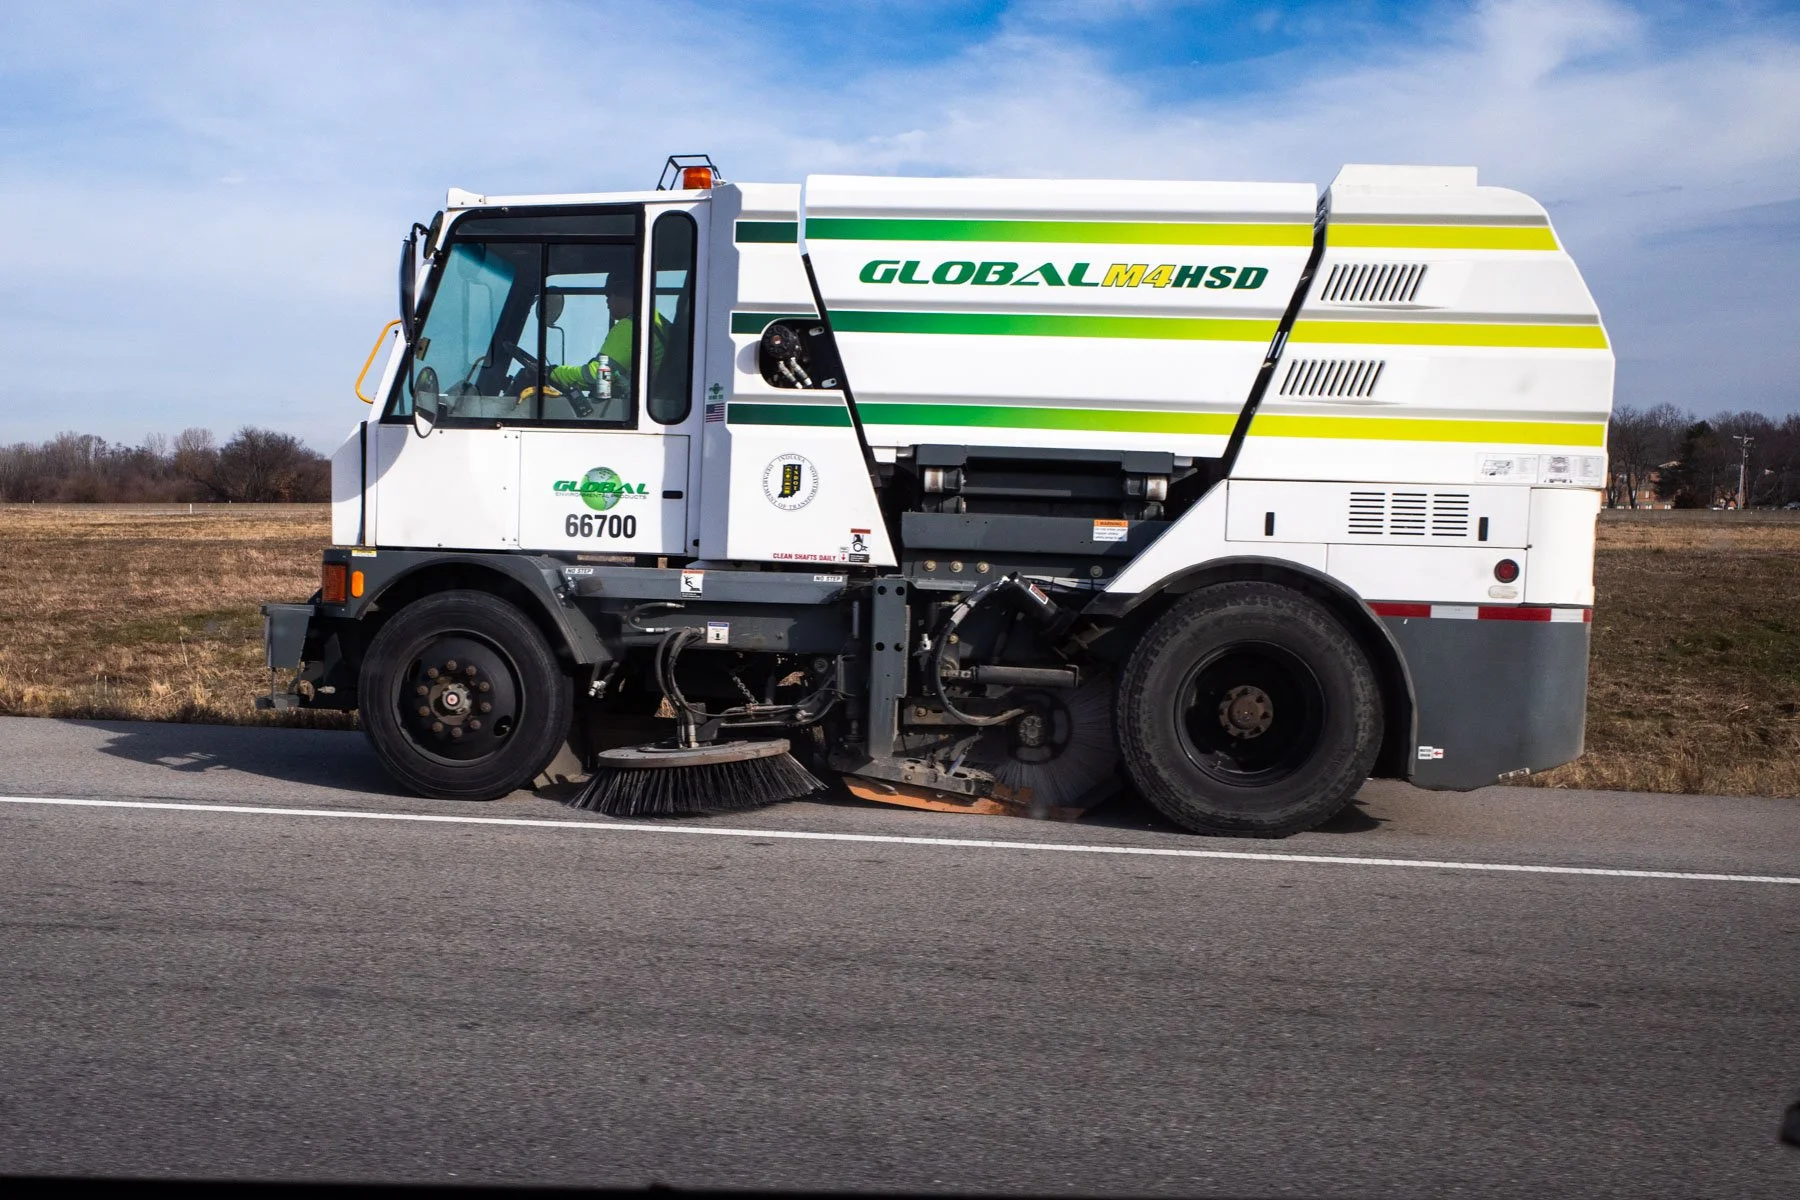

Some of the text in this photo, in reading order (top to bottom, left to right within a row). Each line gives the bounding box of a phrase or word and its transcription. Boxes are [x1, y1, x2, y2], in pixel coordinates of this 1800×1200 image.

[859, 260, 1099, 286] GLOBAL
[777, 455, 805, 463] INDIANA
[553, 480, 650, 494] GLOBAL
[565, 514, 637, 538] 66700
